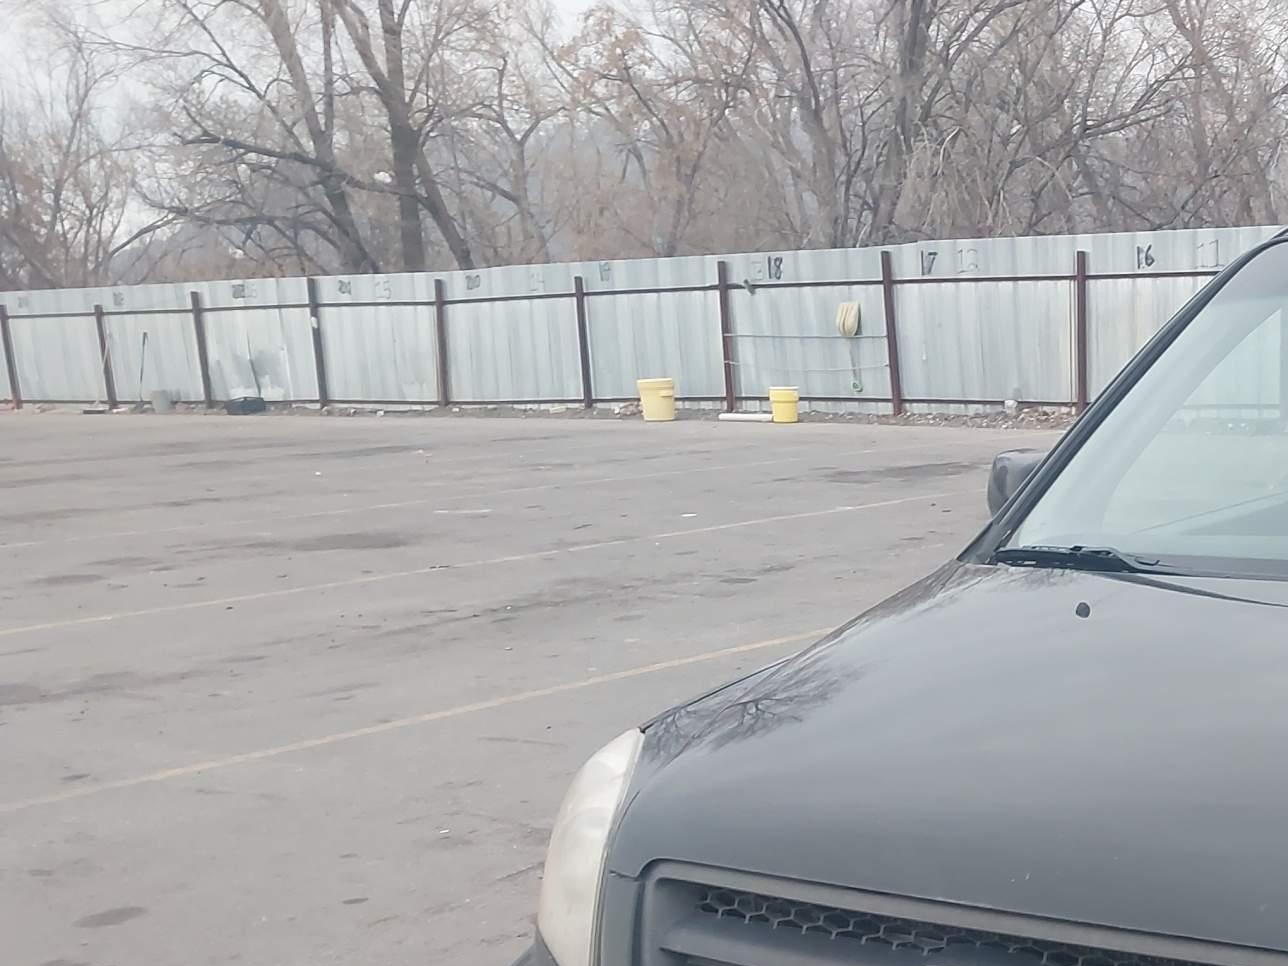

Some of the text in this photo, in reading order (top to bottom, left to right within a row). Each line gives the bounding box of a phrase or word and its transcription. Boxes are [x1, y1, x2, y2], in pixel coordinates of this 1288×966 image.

[767, 255, 784, 281] 18
[920, 250, 938, 276] 17
[1136, 244, 1155, 270] 16
